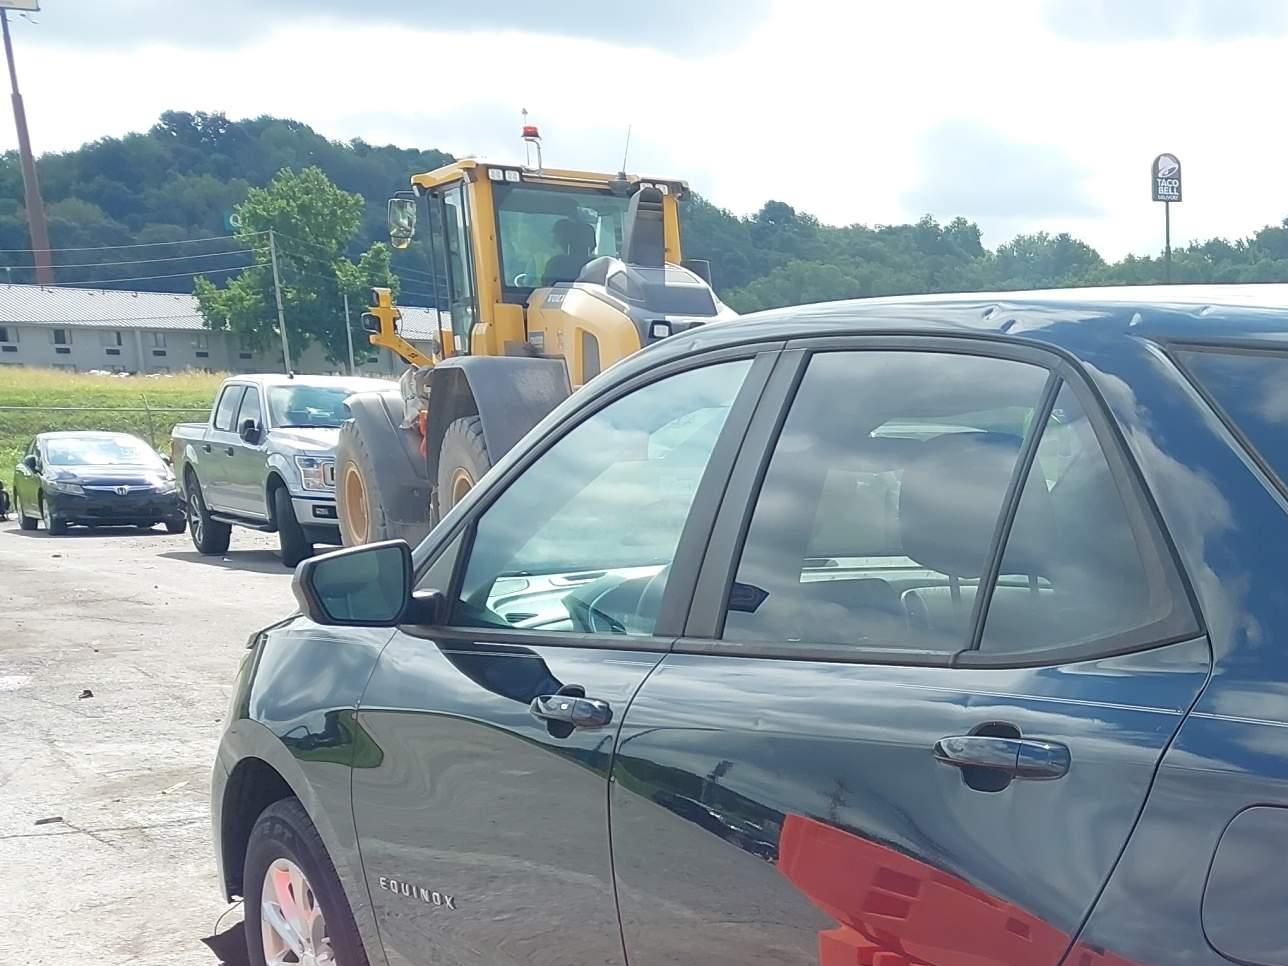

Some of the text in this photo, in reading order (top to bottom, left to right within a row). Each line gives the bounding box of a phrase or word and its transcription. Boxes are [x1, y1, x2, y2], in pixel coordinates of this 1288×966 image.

[1156, 178, 1179, 187] TACO
[1158, 186, 1179, 195] BELL
[379, 876, 456, 910] EQUINOX
